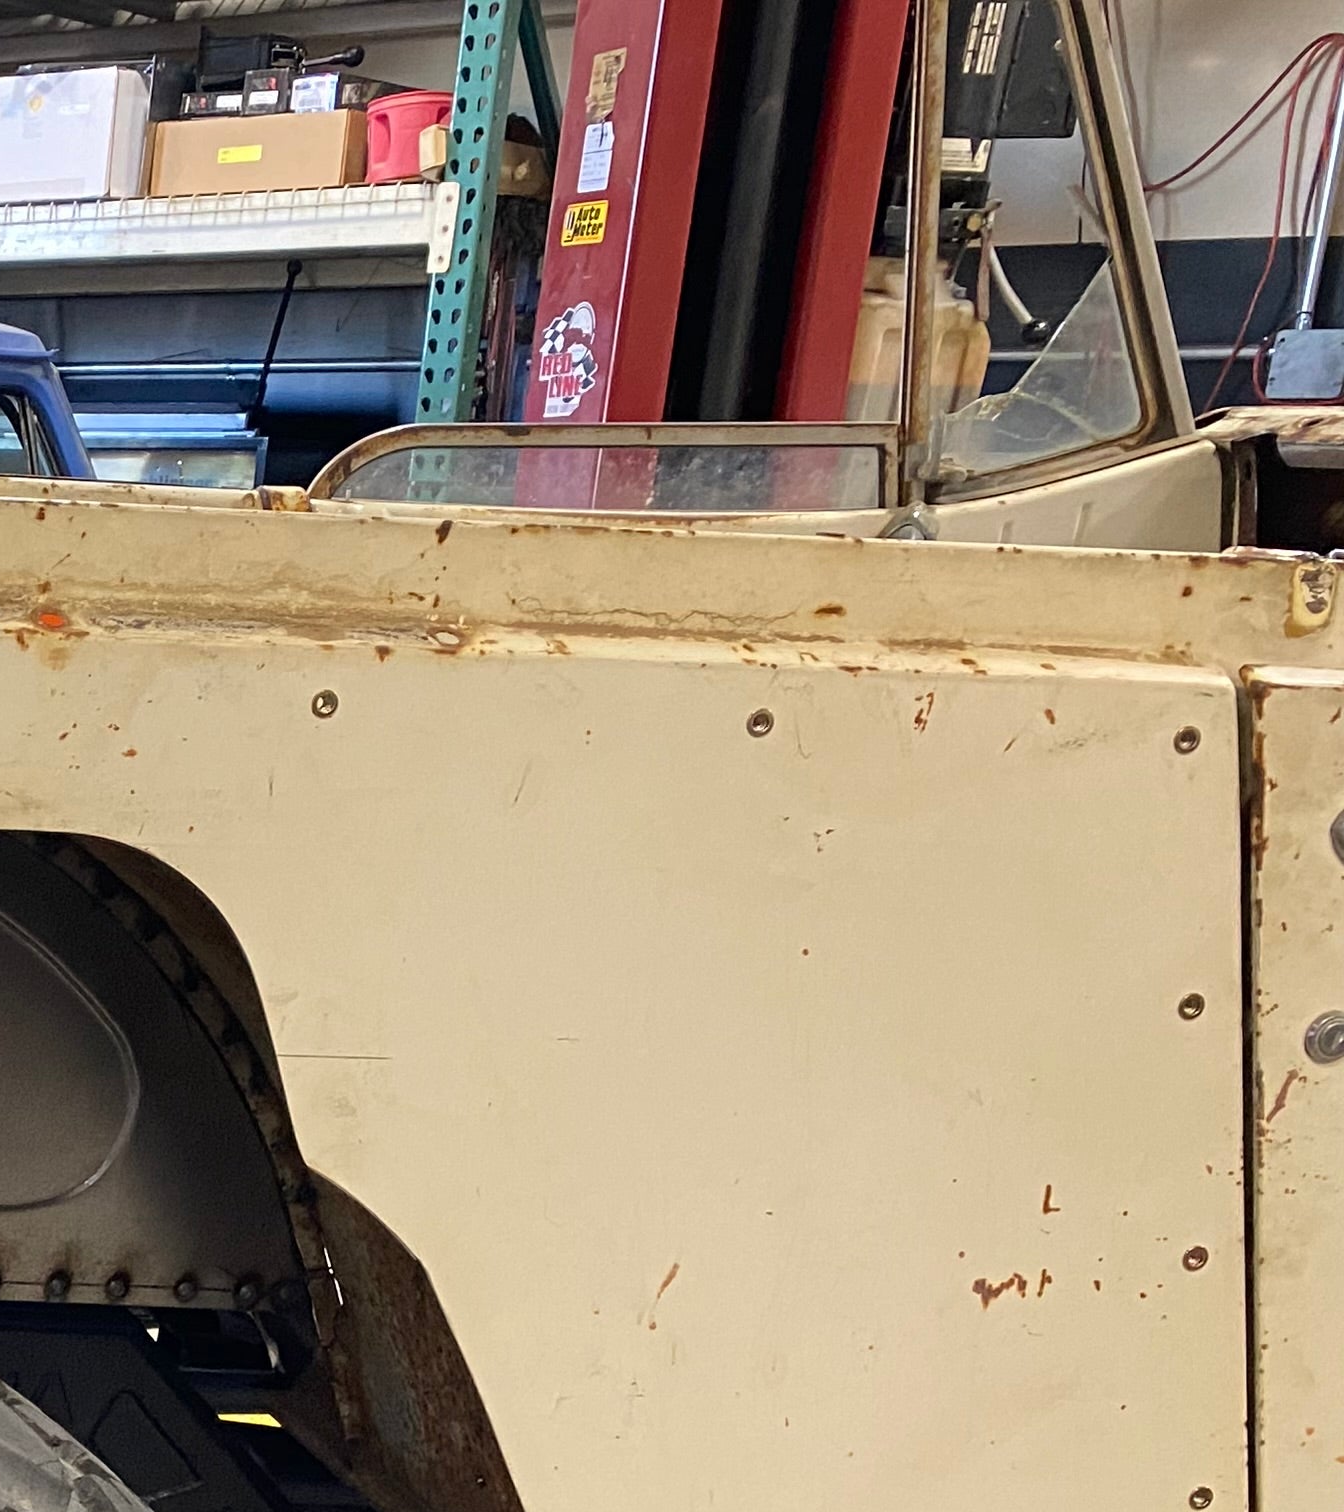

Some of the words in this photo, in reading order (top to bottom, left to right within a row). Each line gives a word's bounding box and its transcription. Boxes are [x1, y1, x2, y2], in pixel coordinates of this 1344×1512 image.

[577, 207, 601, 222] Auto
[574, 221, 604, 237] Meter
[541, 353, 572, 377] RED
